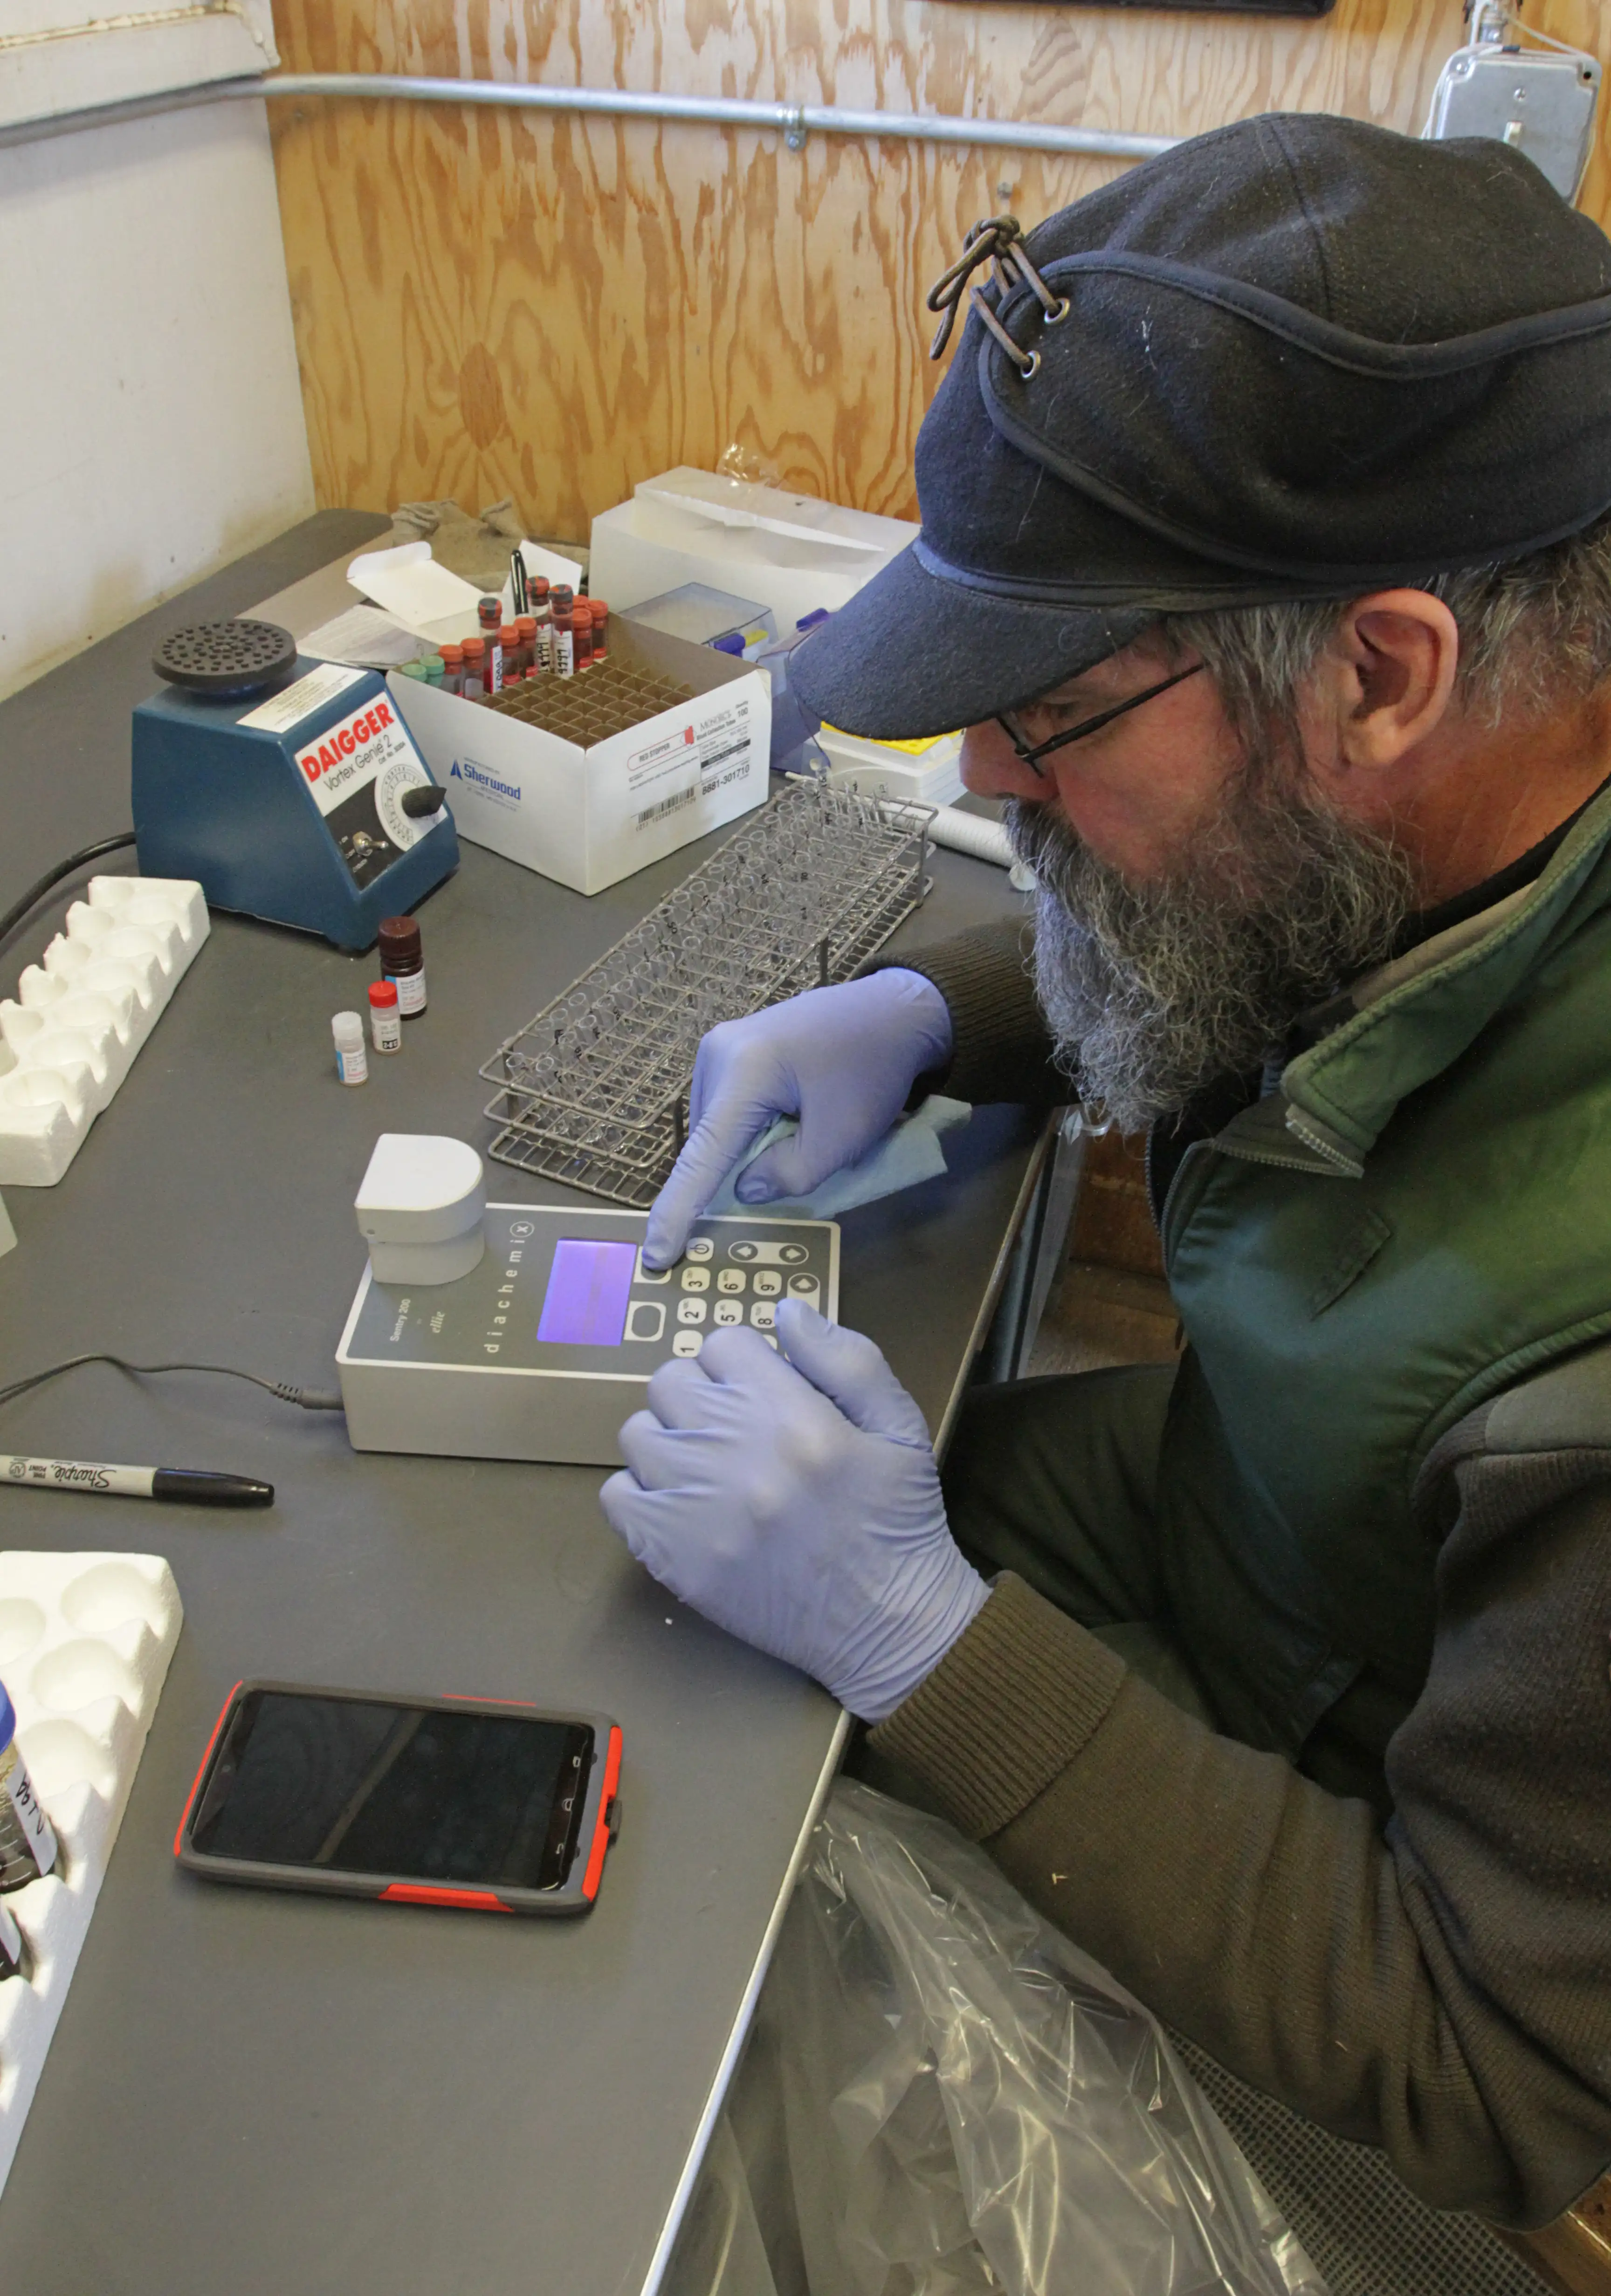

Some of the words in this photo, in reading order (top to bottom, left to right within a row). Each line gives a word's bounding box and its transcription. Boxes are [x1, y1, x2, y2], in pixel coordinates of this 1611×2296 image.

[737, 707, 748, 718] 100
[301, 703, 394, 783] DAIGGER
[639, 752, 649, 762] RED
[649, 742, 670, 758] STOPPER
[324, 764, 356, 791] Vortex
[355, 743, 384, 768] Genie
[383, 734, 392, 747] 2
[702, 764, 750, 795] 8881-301710
[464, 763, 521, 801] Sherwood
[390, 1315, 408, 1342] Sentry
[399, 1298, 411, 1314] 200
[430, 1311, 445, 1334] ellie
